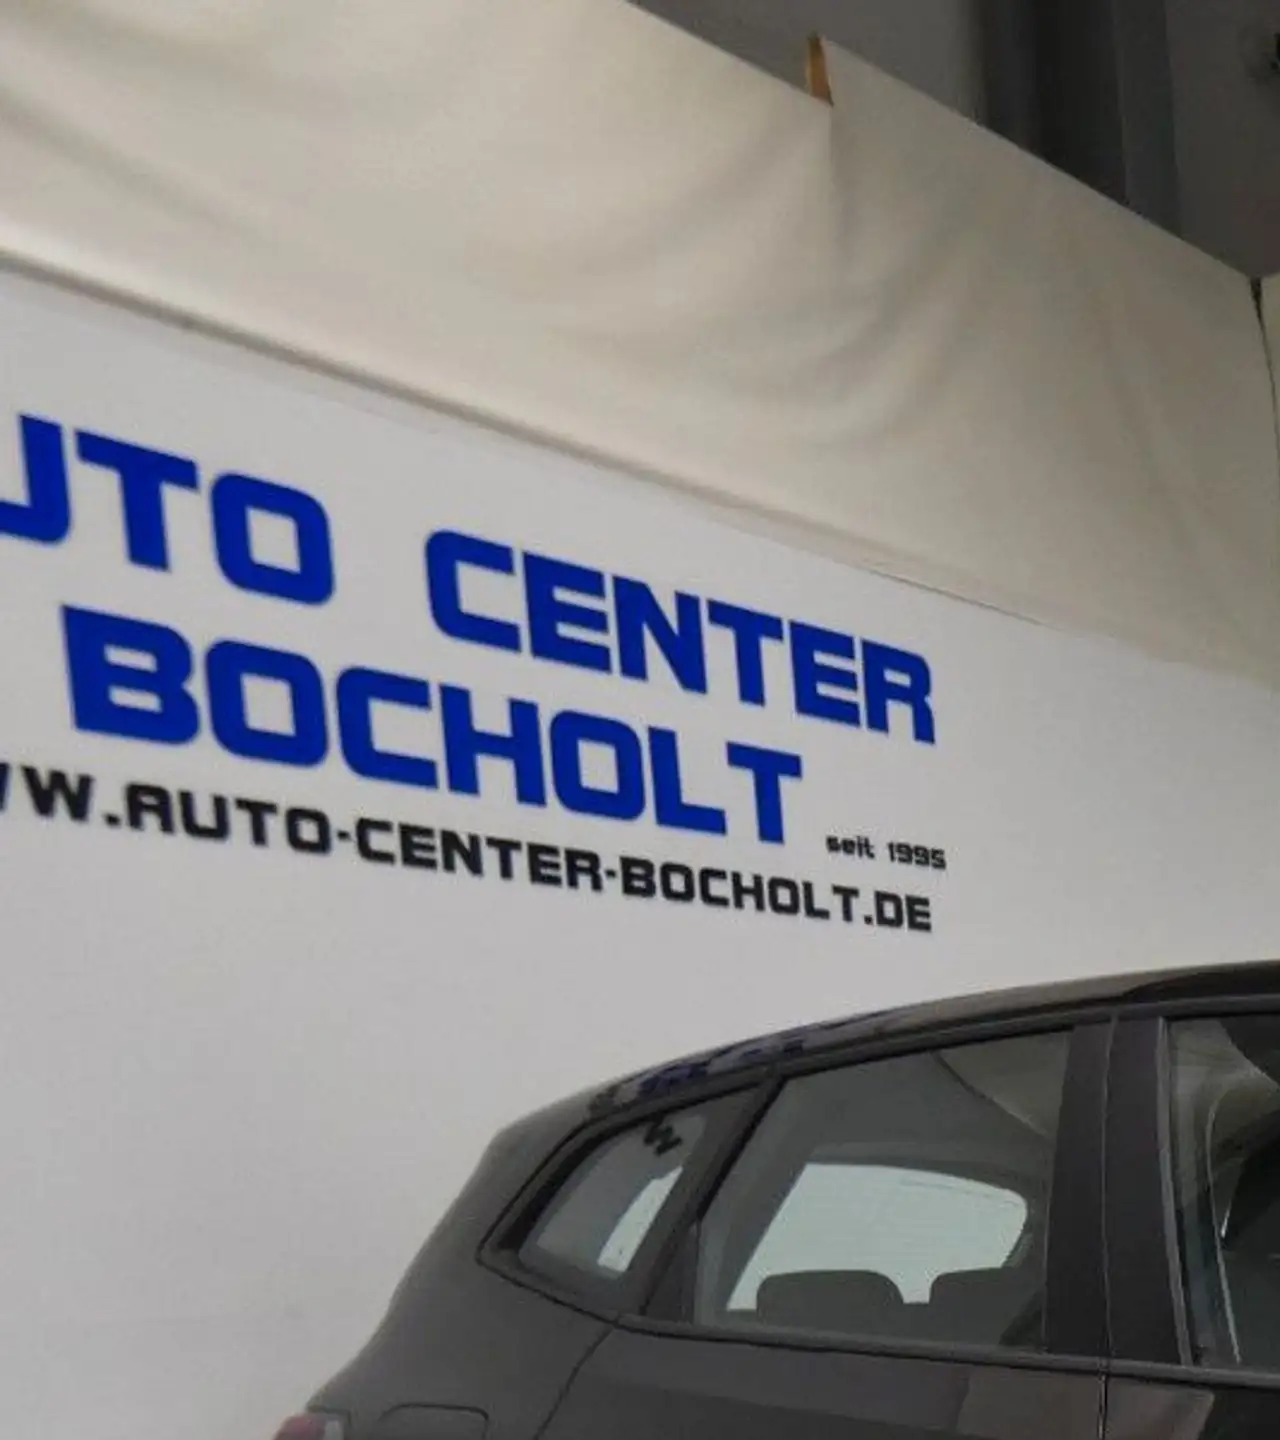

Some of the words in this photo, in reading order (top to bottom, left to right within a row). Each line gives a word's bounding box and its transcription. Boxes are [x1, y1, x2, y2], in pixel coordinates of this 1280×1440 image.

[61, 605, 805, 845] BOCHOLT
[825, 834, 876, 861] seit
[887, 841, 948, 871] 1995
[425, 528, 936, 745] CENTER
[0, 761, 933, 934] W.AUTO-CENTER-BOCHOLT.DE
